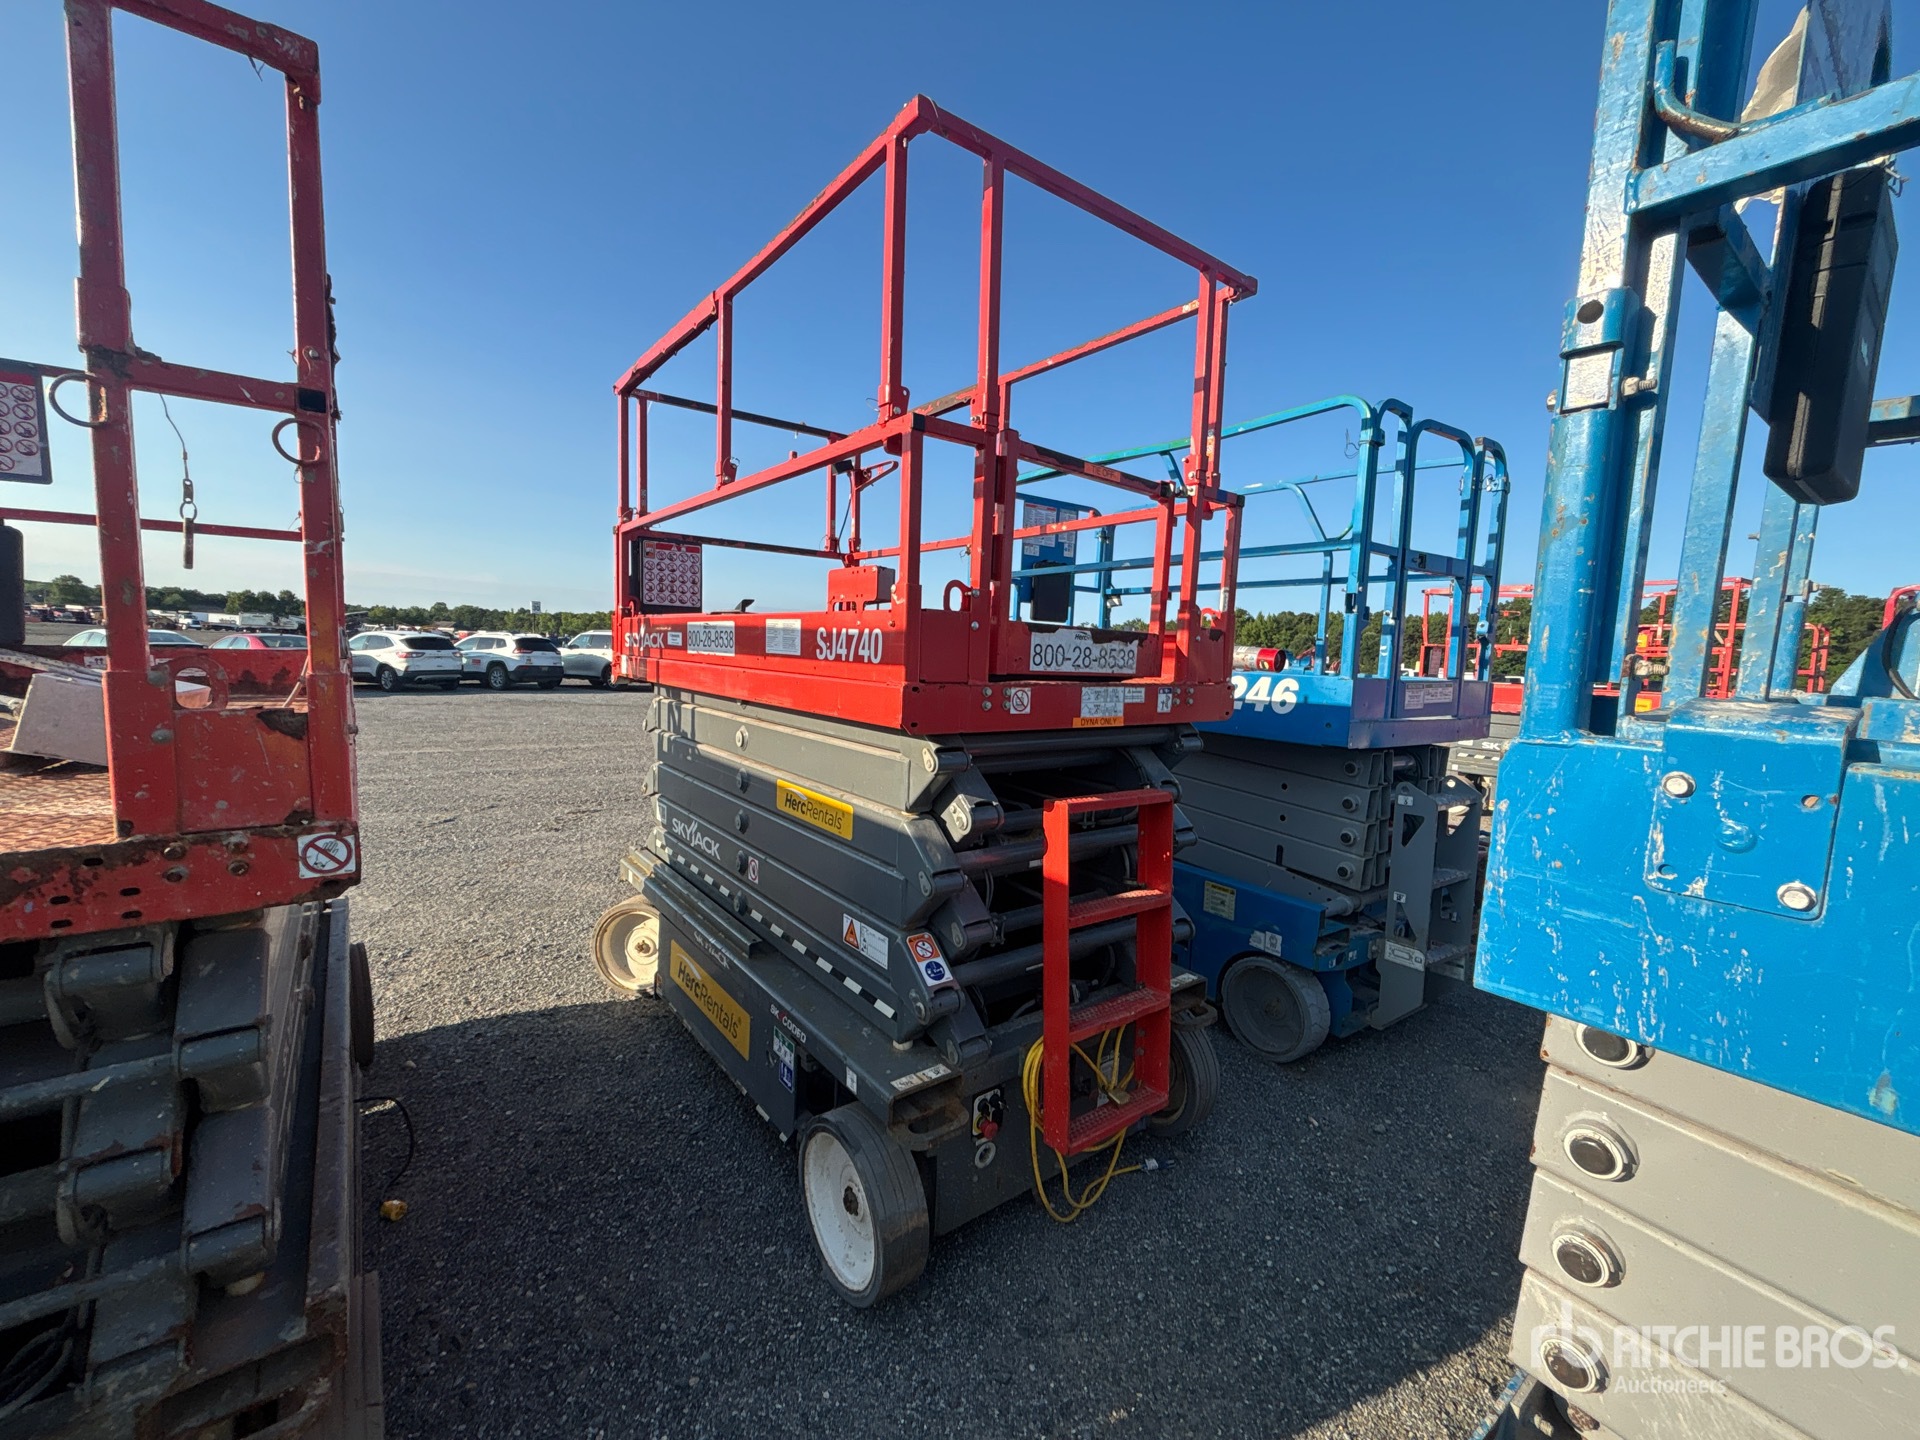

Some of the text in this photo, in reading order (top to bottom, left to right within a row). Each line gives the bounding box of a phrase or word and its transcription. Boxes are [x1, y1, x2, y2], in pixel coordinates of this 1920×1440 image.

[624, 623, 665, 651] SKYJACK
[688, 630, 734, 648] 800-28-8538
[816, 626, 883, 664] SJ4740
[1032, 643, 1136, 669] 800-28-8538
[1080, 718, 1118, 726] DYNA ONLY
[1482, 741, 1501, 751] SK
[784, 792, 844, 830] HercRentals
[672, 817, 721, 861] SKYJACK
[677, 960, 739, 1040] HercRentals
